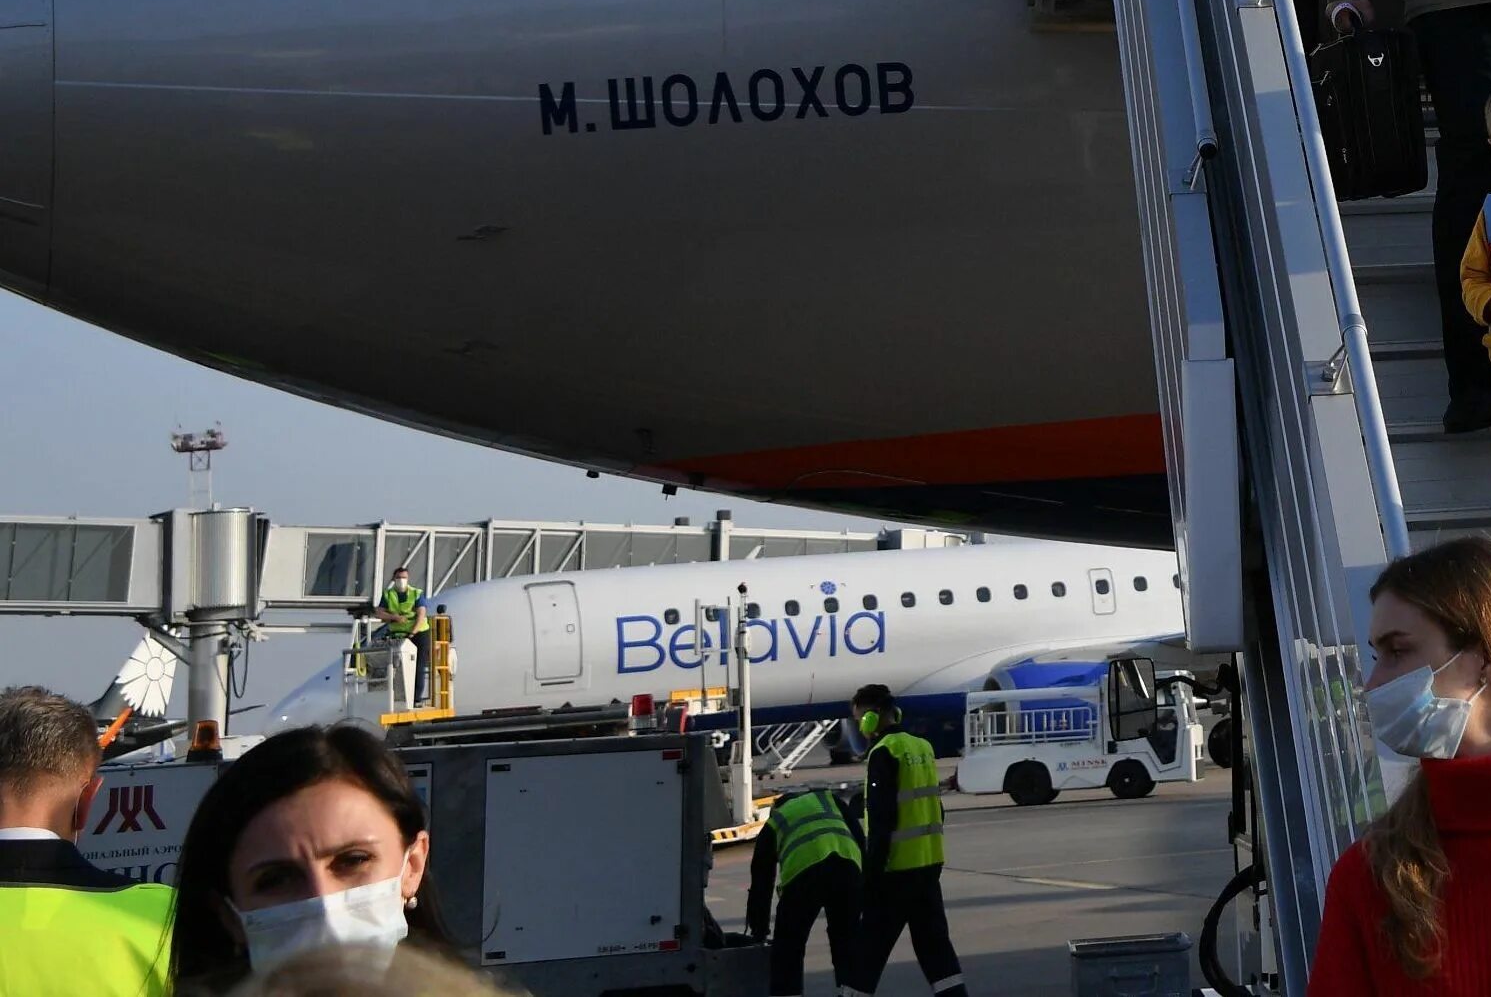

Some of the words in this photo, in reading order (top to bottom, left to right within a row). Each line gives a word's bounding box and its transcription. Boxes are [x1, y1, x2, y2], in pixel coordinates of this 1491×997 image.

[616, 611, 886, 674] Belavia
[81, 845, 150, 861] ОНАЛЬНЫЙ
[154, 844, 184, 856] АЭРО
